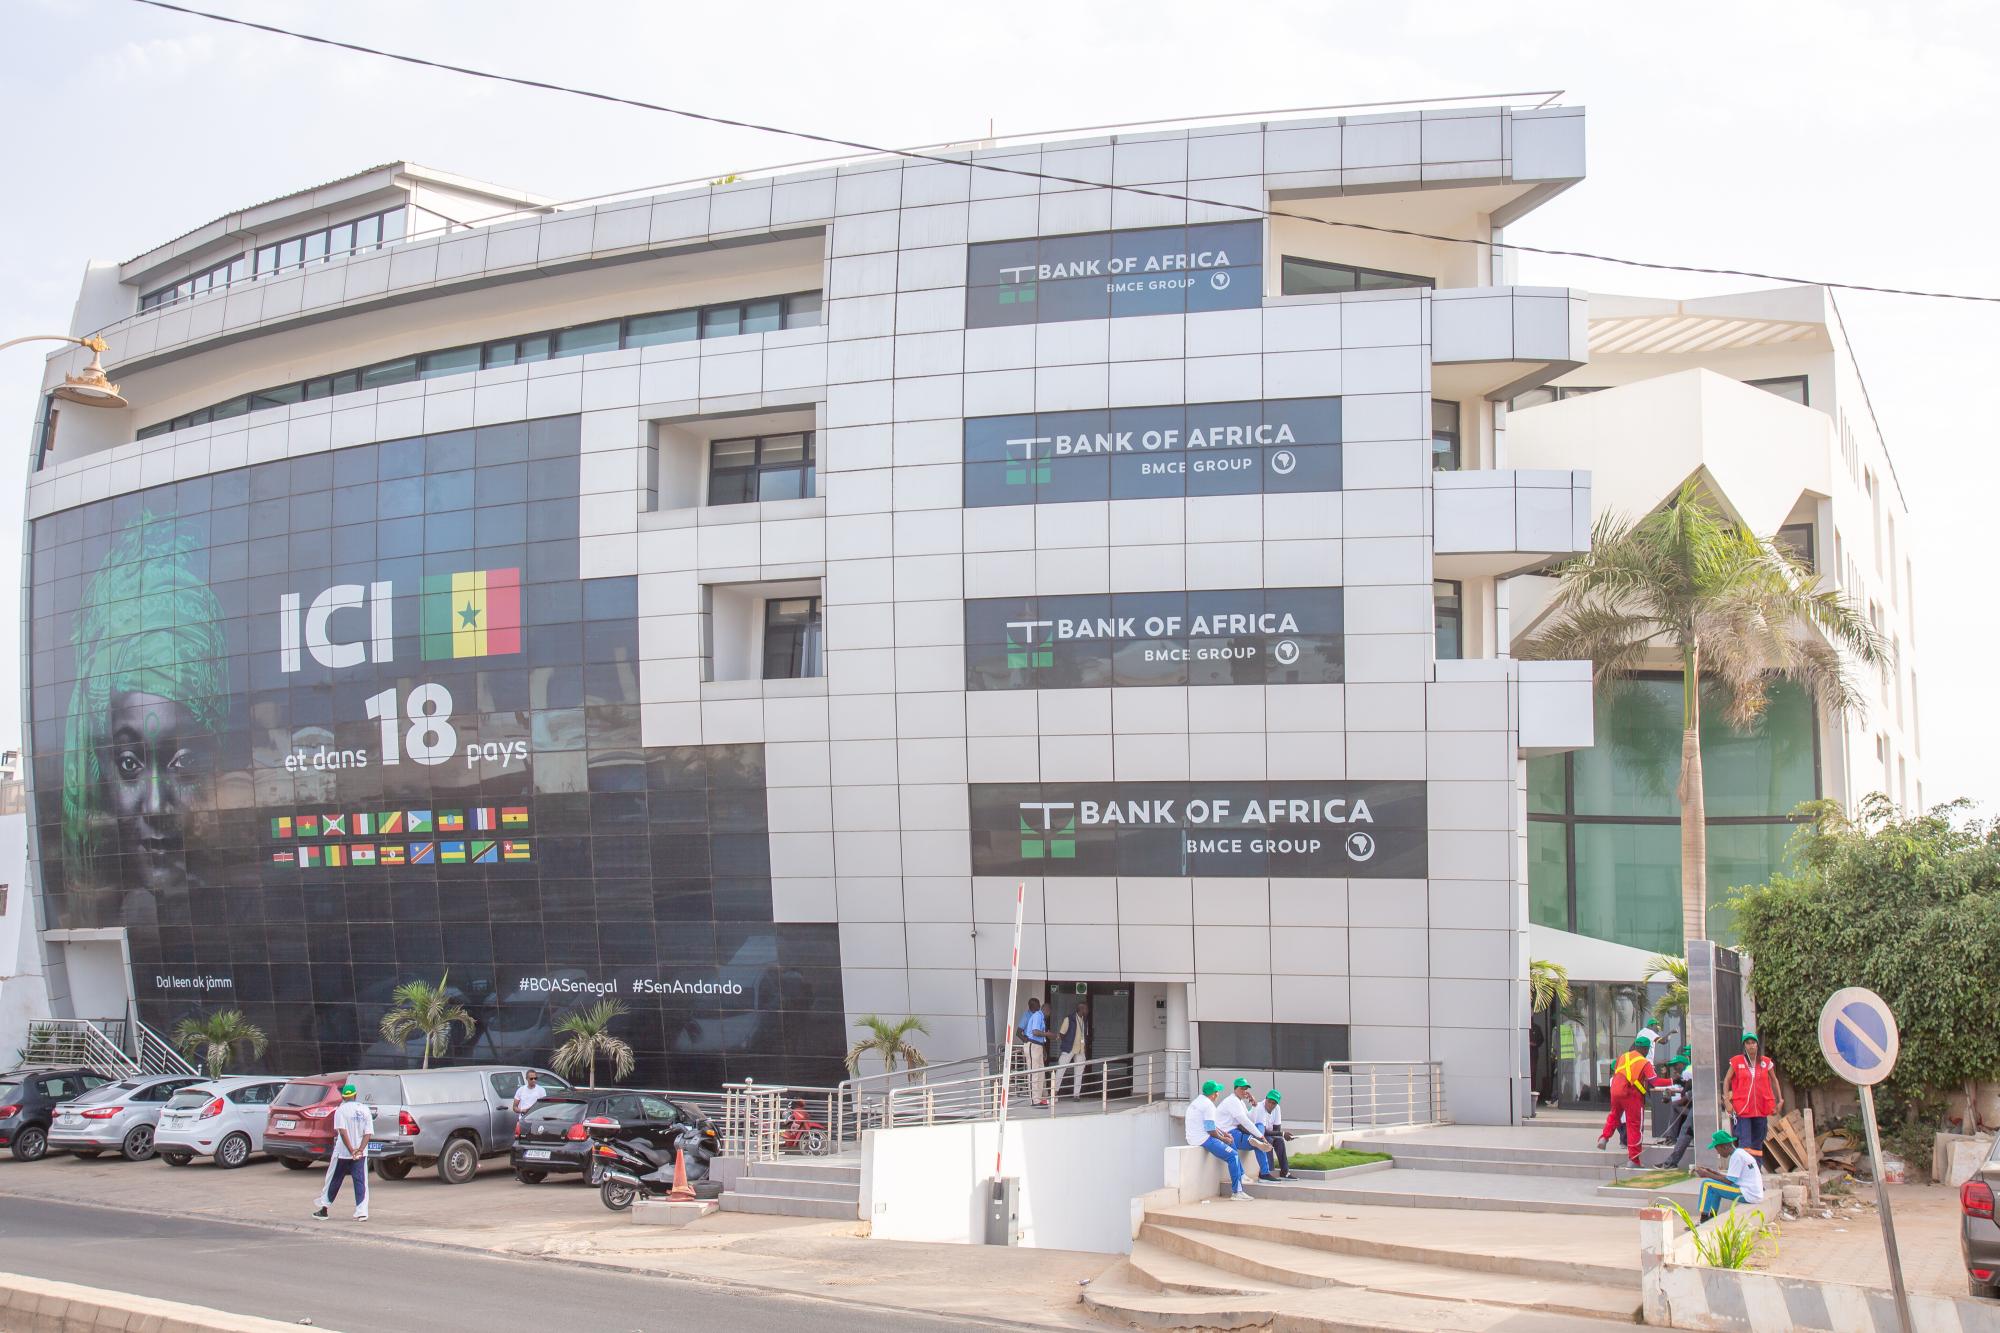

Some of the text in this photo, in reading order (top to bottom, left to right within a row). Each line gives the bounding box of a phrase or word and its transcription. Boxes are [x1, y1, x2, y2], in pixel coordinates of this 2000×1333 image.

[1038, 251, 1231, 280] BANK OF AFRICA
[1106, 278, 1196, 293] BMCE GROUP
[1056, 423, 1296, 455] BANK OF AFRICA
[1141, 458, 1252, 475] BMCE GROUP
[280, 580, 394, 673] ICI
[1058, 613, 1300, 639] BANK OF AFRICA
[1144, 647, 1257, 662] BMCE GROUP
[284, 682, 528, 772] et dans 18 pays
[1080, 799, 1375, 825] BANK OF AFRICA
[1186, 839, 1321, 854] BMCE GROUP
[156, 975, 171, 988] Dal
[172, 976, 191, 988] leen
[192, 976, 205, 988] ak
[519, 978, 743, 997] #BOASenegal #SenAndando
